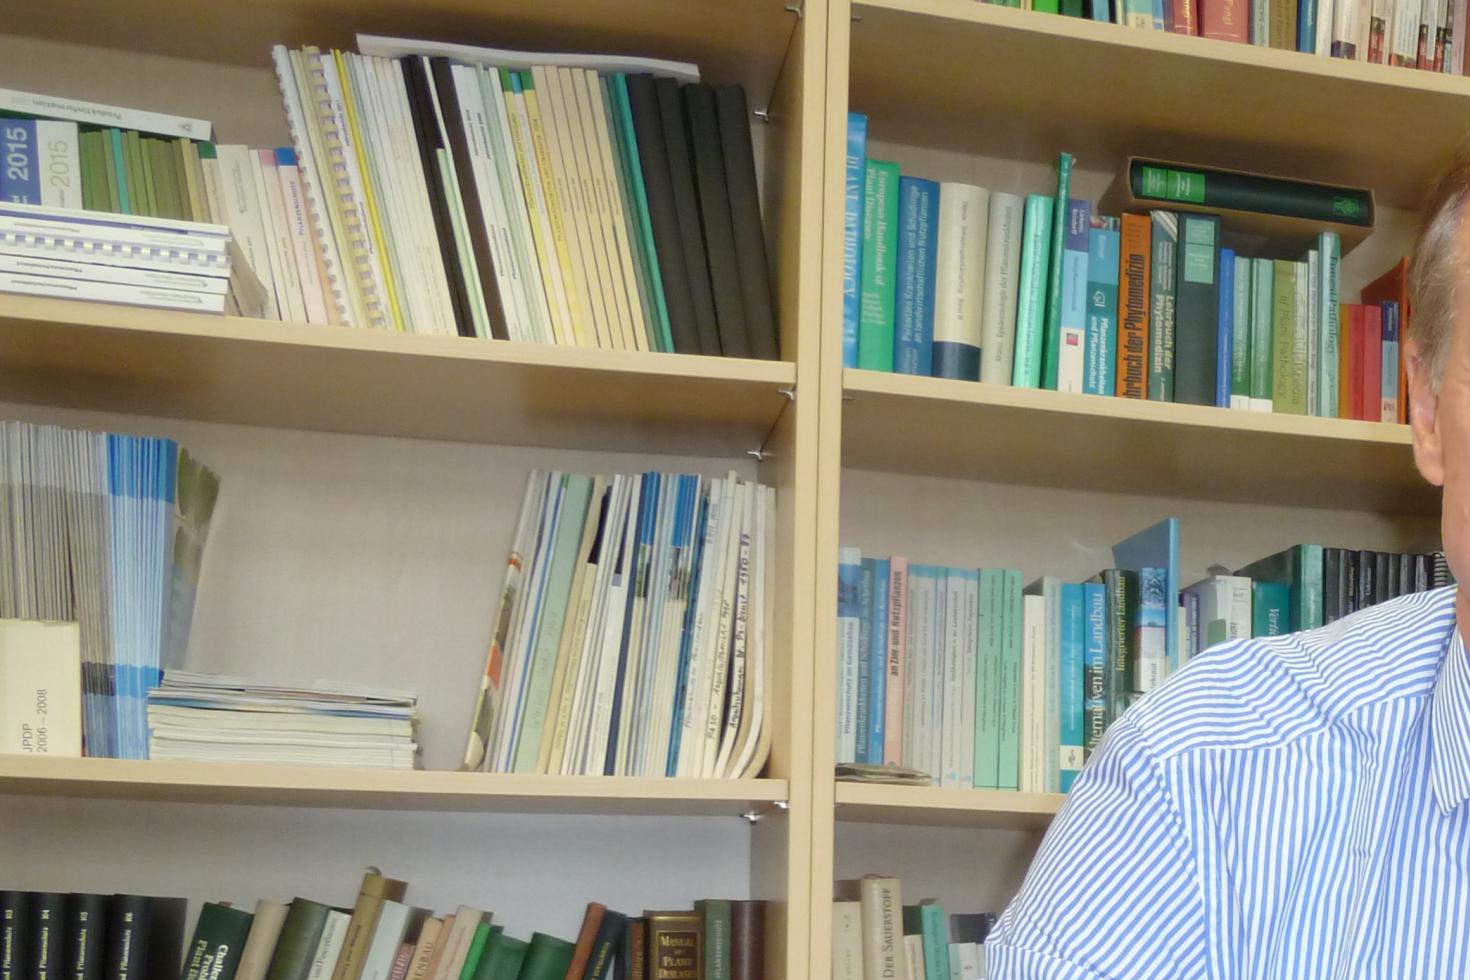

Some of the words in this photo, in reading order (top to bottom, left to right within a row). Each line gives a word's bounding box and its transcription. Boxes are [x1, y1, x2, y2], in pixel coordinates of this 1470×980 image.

[7, 127, 28, 180] 2015
[50, 140, 69, 188] 2015
[865, 168, 876, 194] Plant
[875, 170, 888, 218] European
[863, 196, 874, 239] Diseases
[907, 185, 919, 230] Schädlinge
[918, 191, 929, 246] Nutzpflanzen
[842, 211, 858, 297] PATHOLOGY
[875, 224, 886, 268] Handbook
[907, 232, 916, 248] und
[874, 273, 884, 284] of
[905, 249, 915, 299] Krankheiten
[915, 248, 926, 332] landwirtschaftlichen
[1125, 254, 1148, 331] Phytomedizin
[903, 300, 913, 340] Parasitäre
[1091, 316, 1099, 331] und
[1154, 294, 1163, 373] Phytomedizin
[1165, 295, 1174, 351] Lehrbuch
[1279, 308, 1288, 334] Plant
[1088, 332, 1098, 388] Pflanzenschutz
[1100, 317, 1110, 395] Pflanzenkrankheiten
[1125, 332, 1143, 351] der
[1277, 341, 1288, 398] Pathology
[890, 570, 903, 626] Nutzpflanzen
[1116, 575, 1126, 615] Landbau
[890, 630, 899, 645] und
[1088, 592, 1104, 652] Landbau
[1088, 656, 1102, 673] im
[1114, 618, 1128, 671] Integrierter
[889, 665, 898, 675] an
[37, 689, 47, 714] 2008
[23, 722, 33, 752] JPDP
[37, 727, 47, 752] 2006
[880, 887, 893, 952] SAUERSTOFF
[38, 927, 49, 968] Pflanzenschutz
[119, 929, 131, 970] Pflanzenschutz
[194, 939, 208, 967] Plant
[663, 956, 692, 966] PLANT
[882, 955, 894, 977] DER
[38, 971, 46, 980] und
